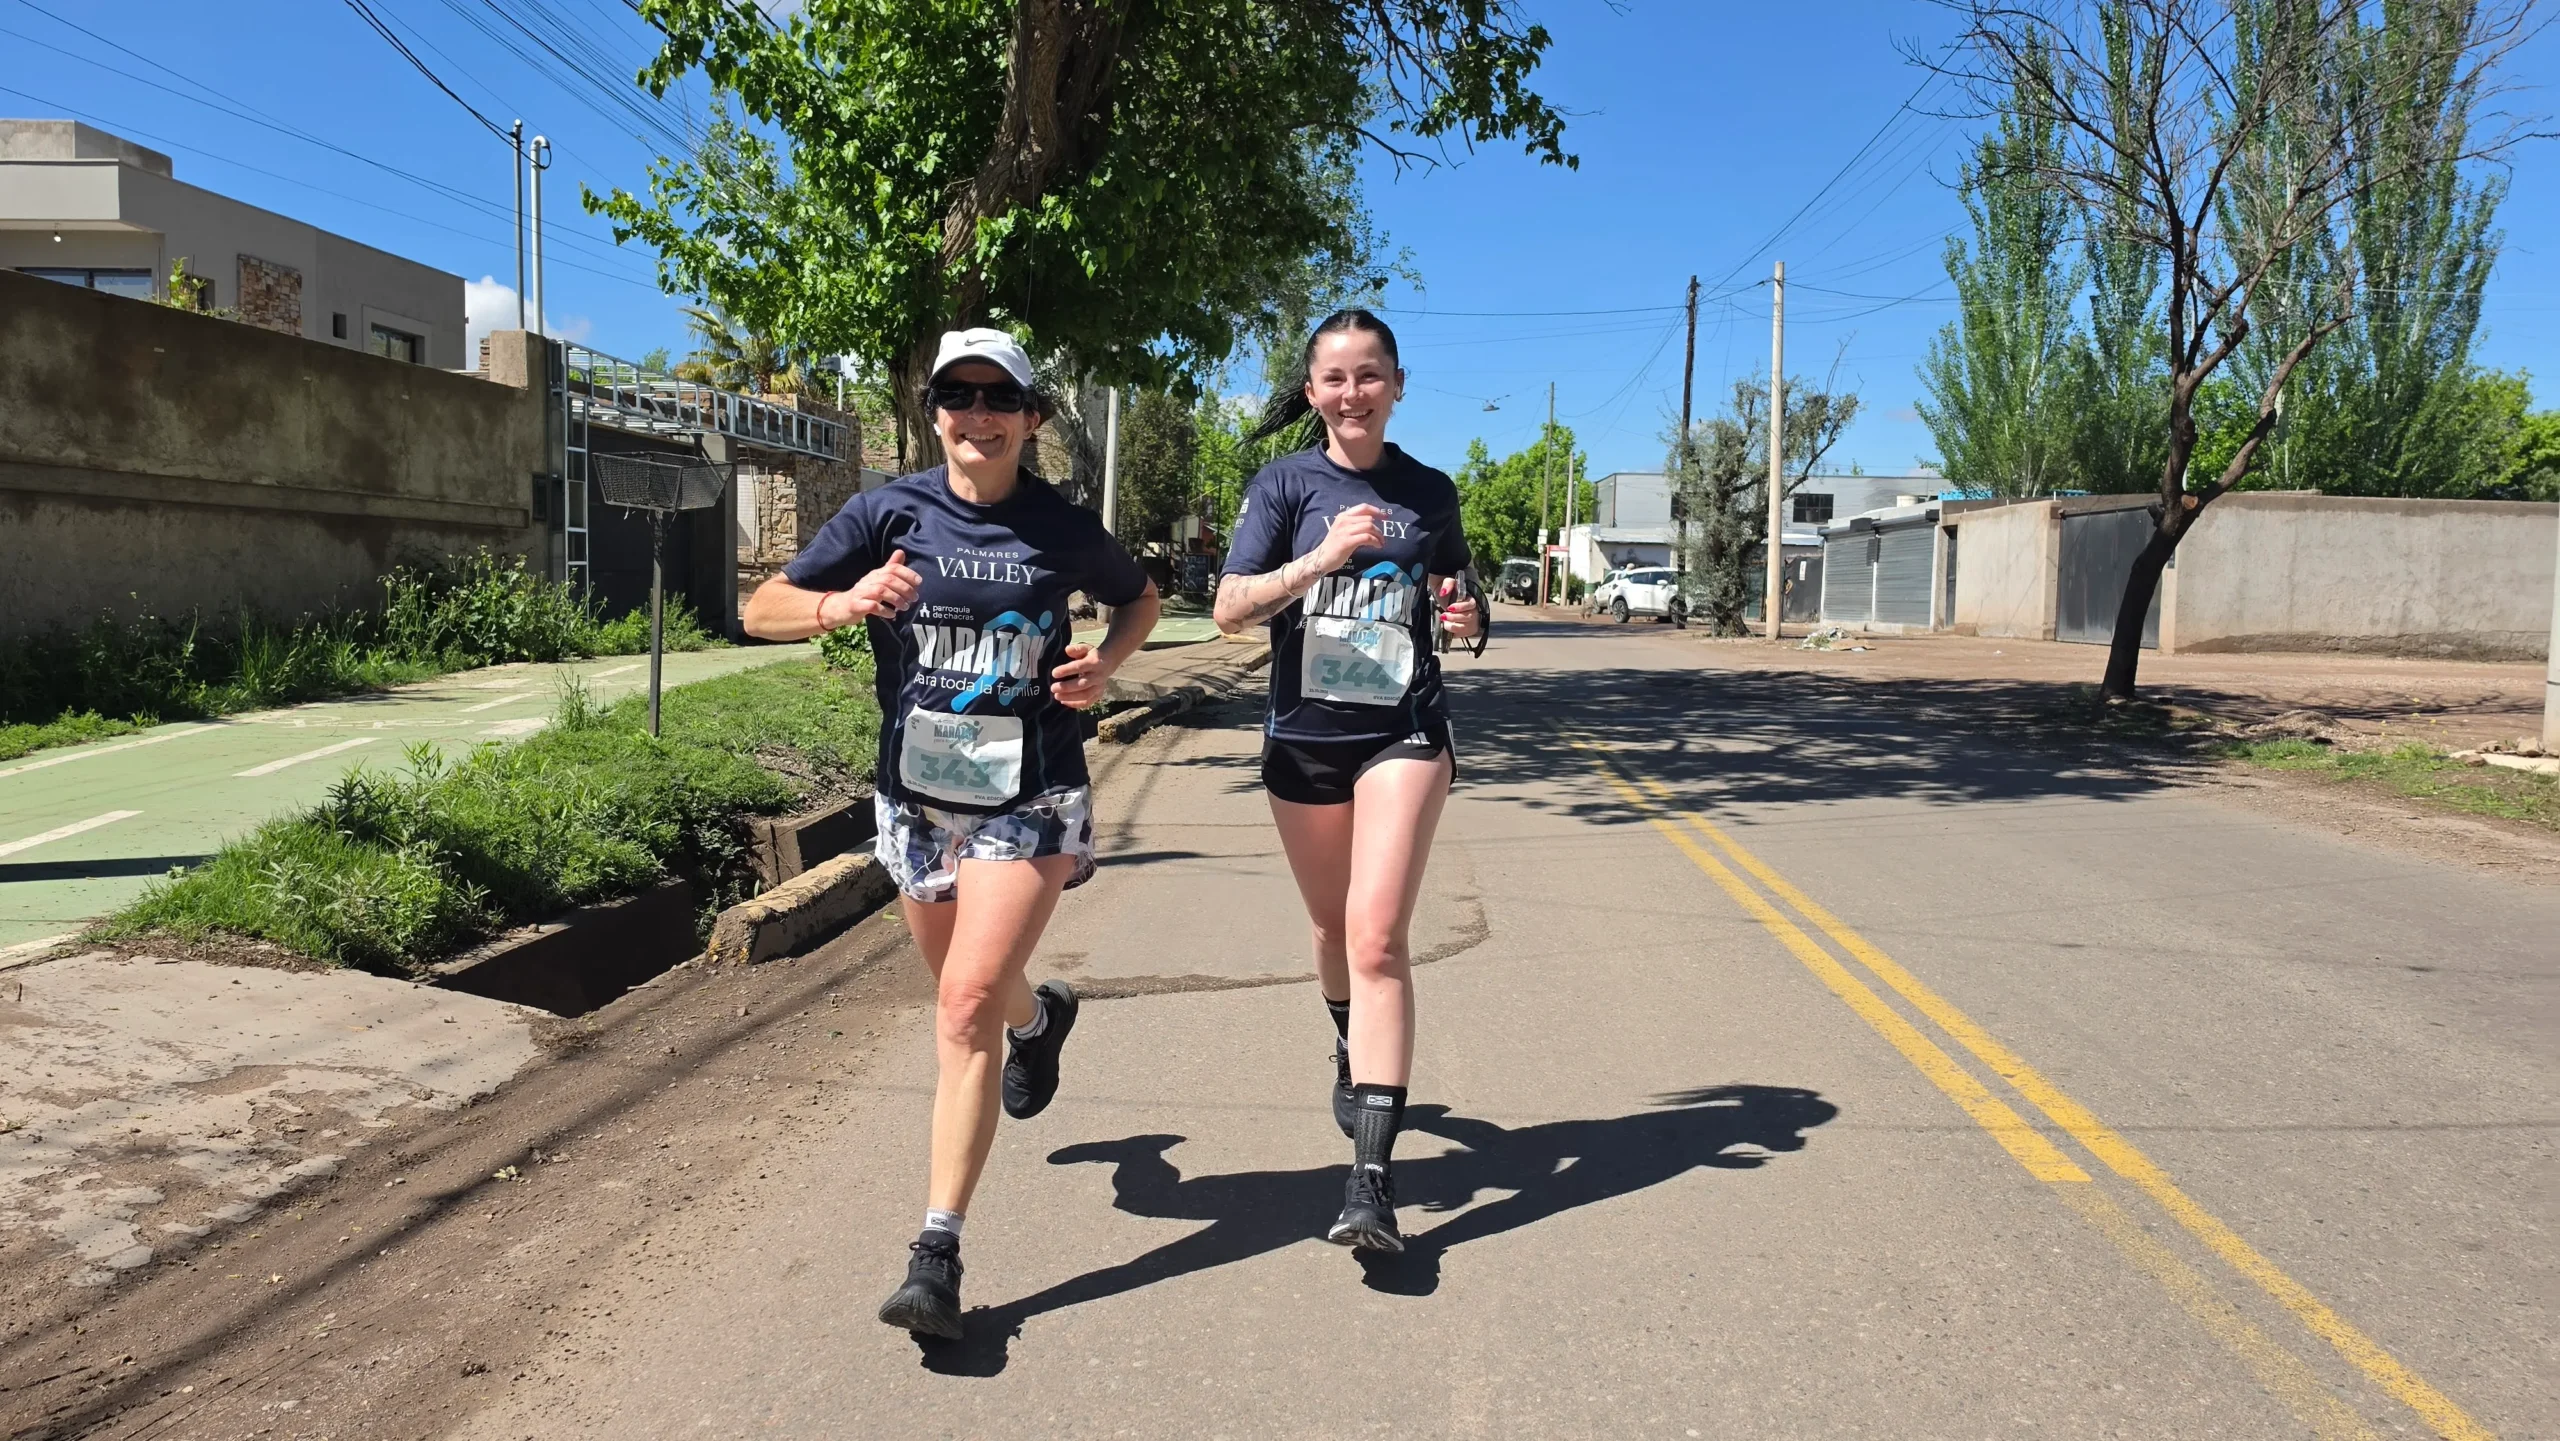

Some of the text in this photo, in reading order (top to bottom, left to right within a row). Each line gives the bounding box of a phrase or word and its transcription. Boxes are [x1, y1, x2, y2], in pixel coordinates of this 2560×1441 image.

[1339, 504, 1393, 515] PAES
[1322, 516, 1410, 539] VEY
[956, 547, 1019, 559] PALMARES
[936, 556, 1037, 586] VALLEY
[932, 605, 971, 614] parroquia
[944, 613, 975, 621] chacras
[1321, 659, 1389, 689] 344
[913, 671, 1040, 697] para toda la familia
[920, 754, 990, 788] 343
[1364, 1163, 1383, 1173] HOKA
